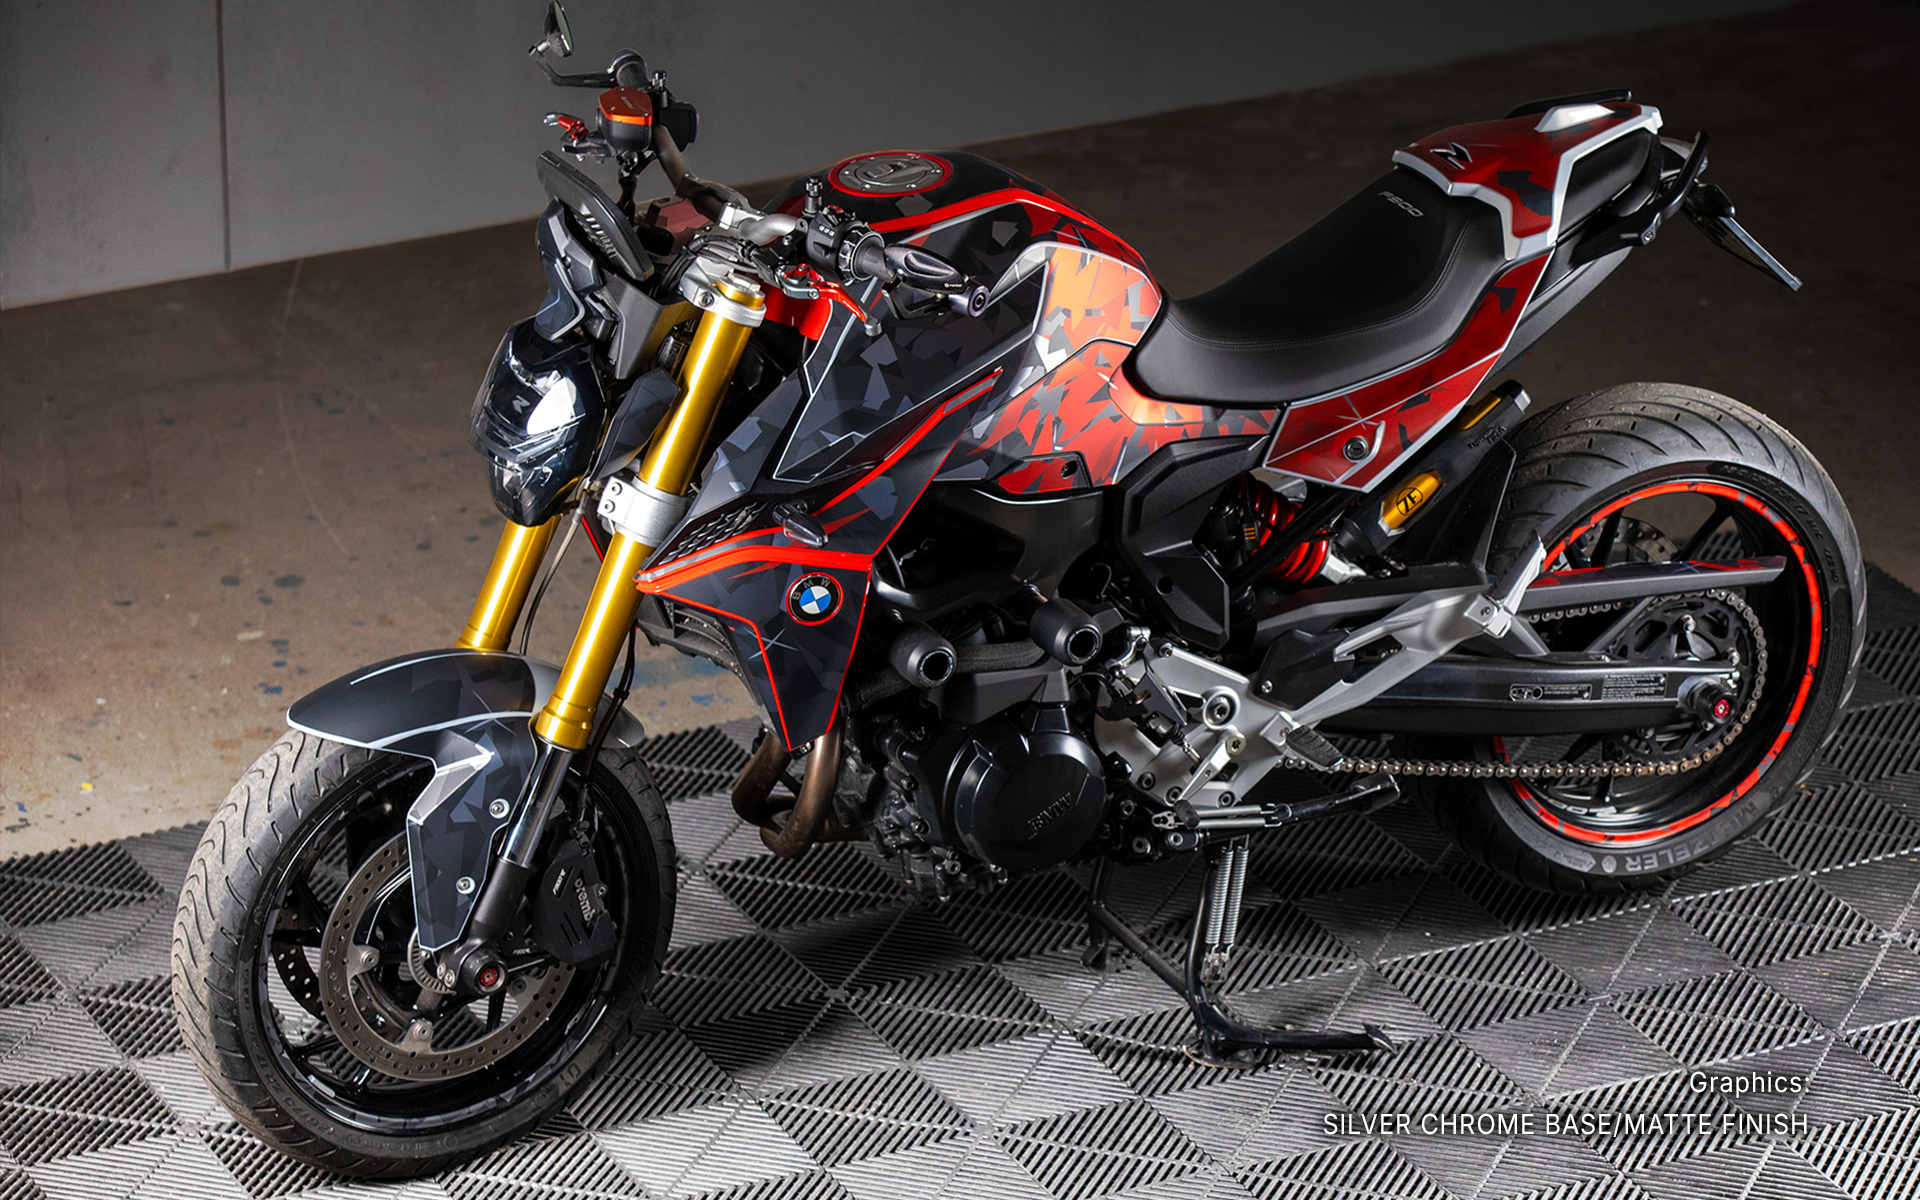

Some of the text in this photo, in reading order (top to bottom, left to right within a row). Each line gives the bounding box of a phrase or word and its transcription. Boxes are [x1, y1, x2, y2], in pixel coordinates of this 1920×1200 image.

[1378, 190, 1424, 217] F900
[1396, 488, 1418, 514] ZF
[791, 578, 831, 600] BMW
[1027, 792, 1072, 834] BMW
[1624, 804, 1760, 873] METZELER
